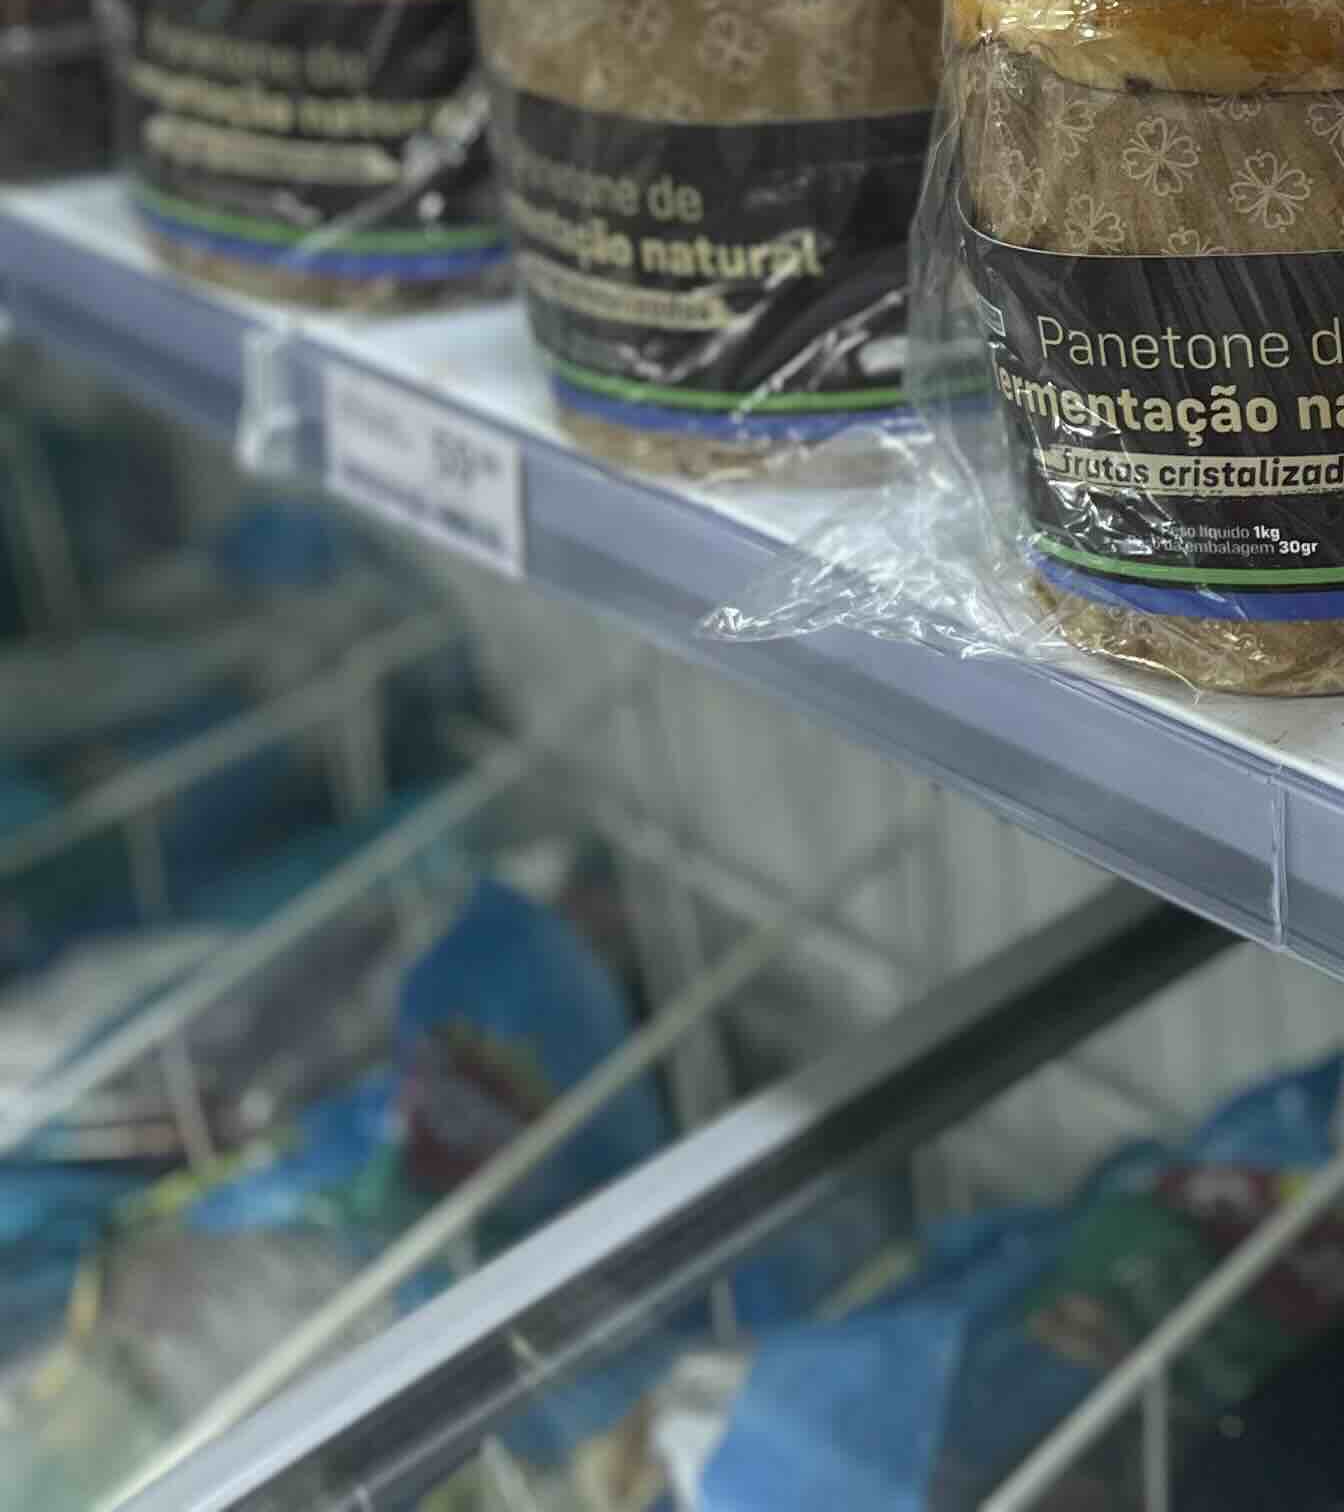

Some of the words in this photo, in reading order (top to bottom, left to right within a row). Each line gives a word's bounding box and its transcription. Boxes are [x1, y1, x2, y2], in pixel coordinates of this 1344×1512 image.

[1037, 315, 1290, 369] Panetone
[1252, 525, 1281, 541] 1kg
[1184, 539, 1275, 556] embalagem
[1278, 540, 1320, 556] 30gr
